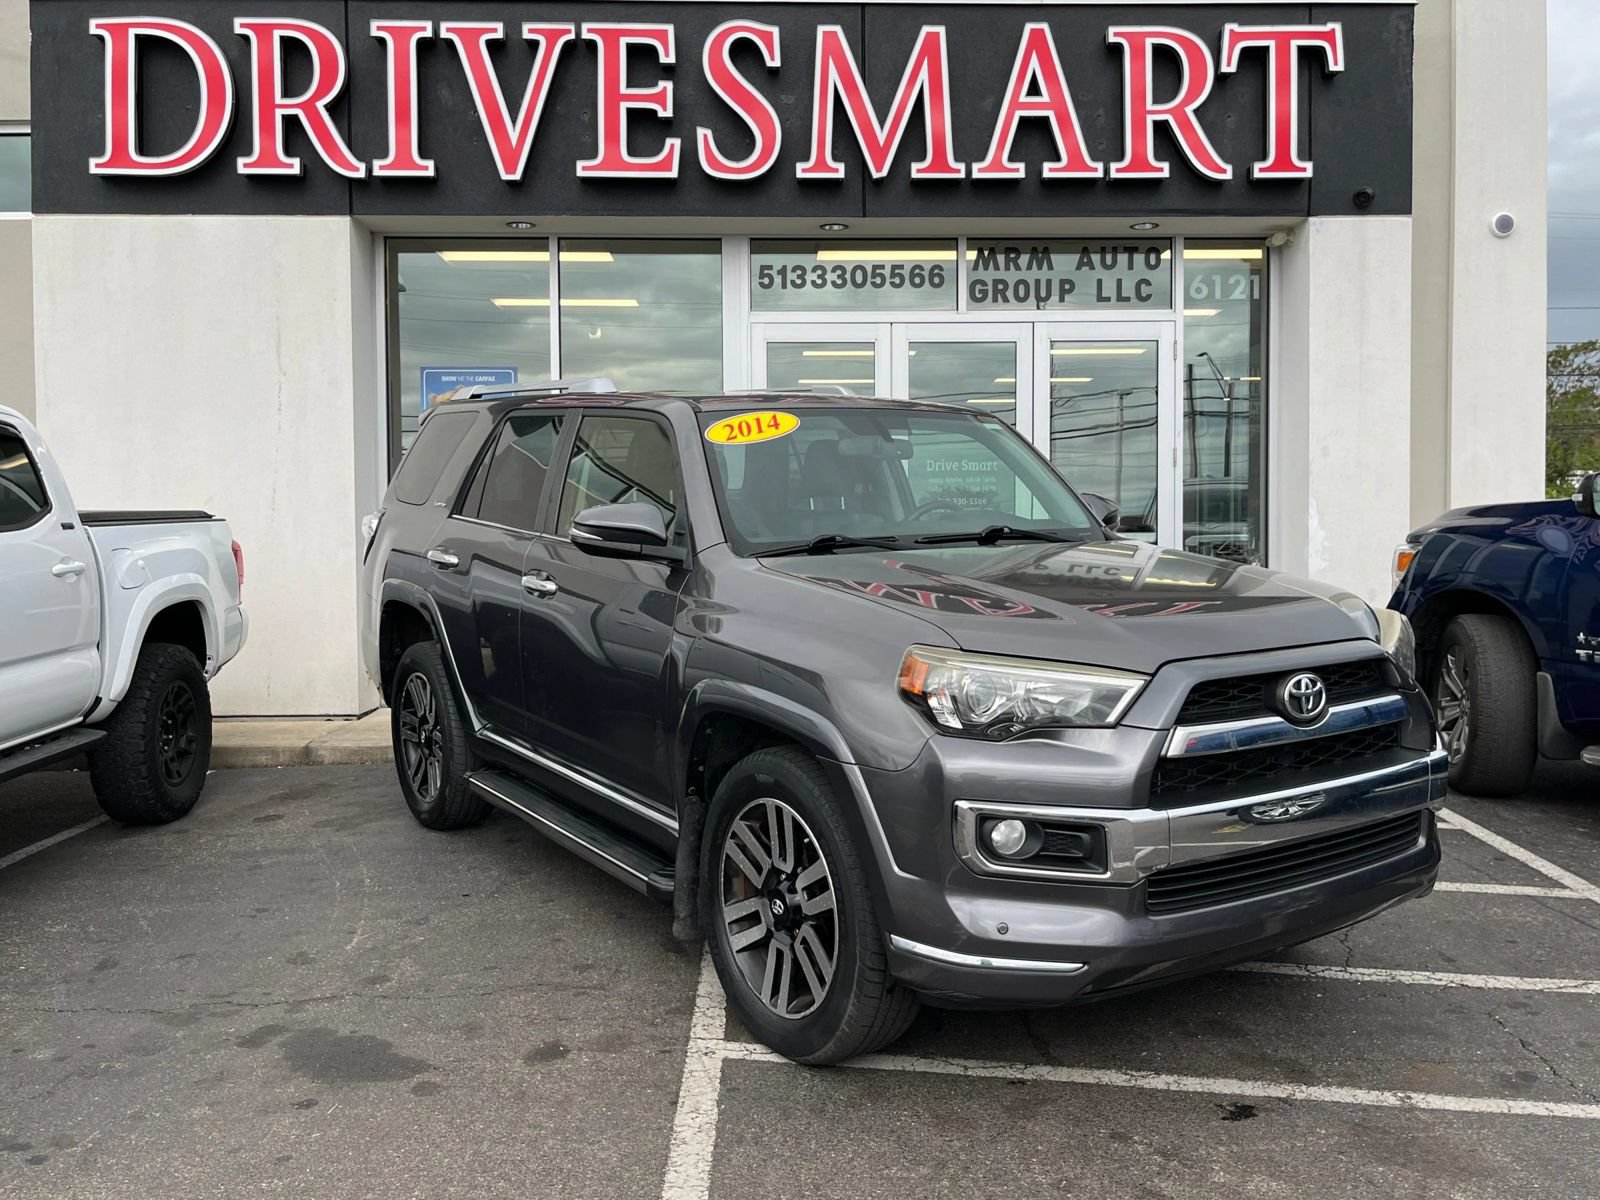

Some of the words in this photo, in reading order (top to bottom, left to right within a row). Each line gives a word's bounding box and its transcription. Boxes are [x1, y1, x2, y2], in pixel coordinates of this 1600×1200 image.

[973, 246, 1054, 271] MRM
[1075, 246, 1162, 271] AUTO
[758, 264, 945, 290] 5133305566
[1189, 274, 1260, 300] 6121
[969, 278, 1076, 303] GROUP
[1096, 278, 1153, 303] LLC
[723, 414, 780, 441] 2014
[927, 459, 959, 472] Drive
[961, 459, 999, 472] Smart
